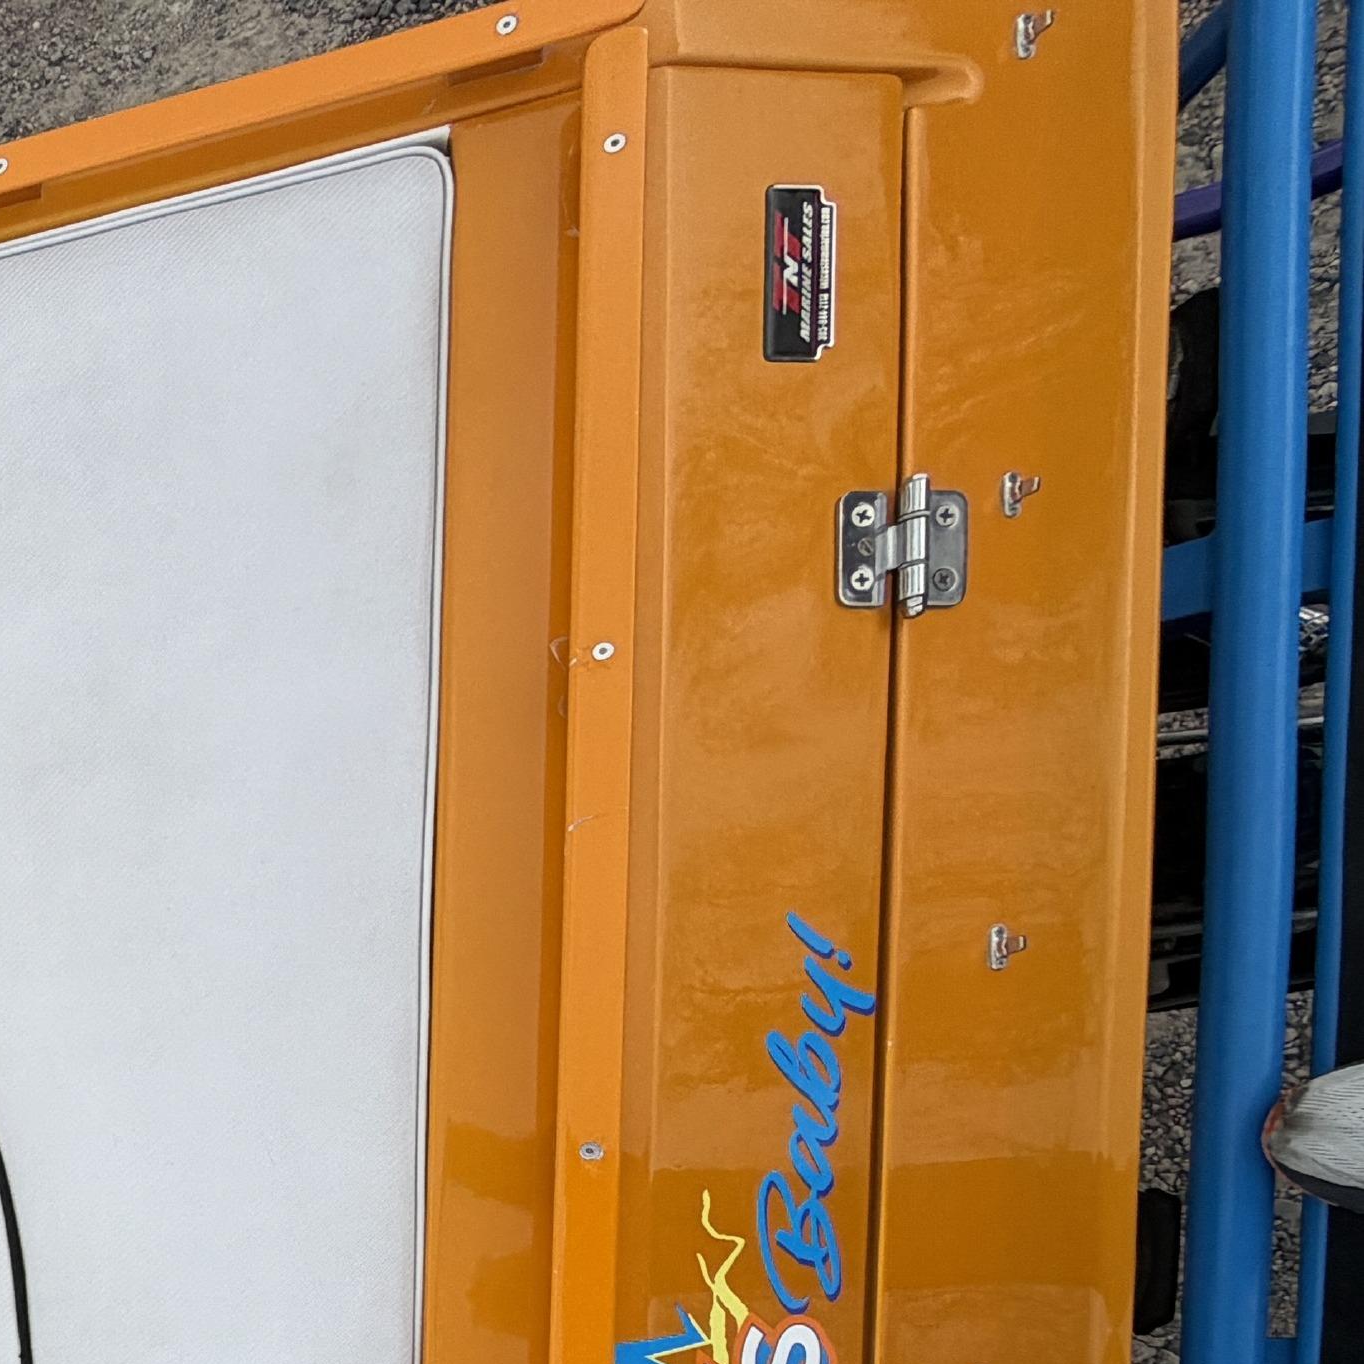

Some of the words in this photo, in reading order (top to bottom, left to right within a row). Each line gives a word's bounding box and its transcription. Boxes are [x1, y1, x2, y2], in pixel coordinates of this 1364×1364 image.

[772, 209, 801, 315] TNT
[801, 201, 814, 263] SALES
[799, 263, 813, 343] MARINE
[757, 911, 876, 1311] Baby!
